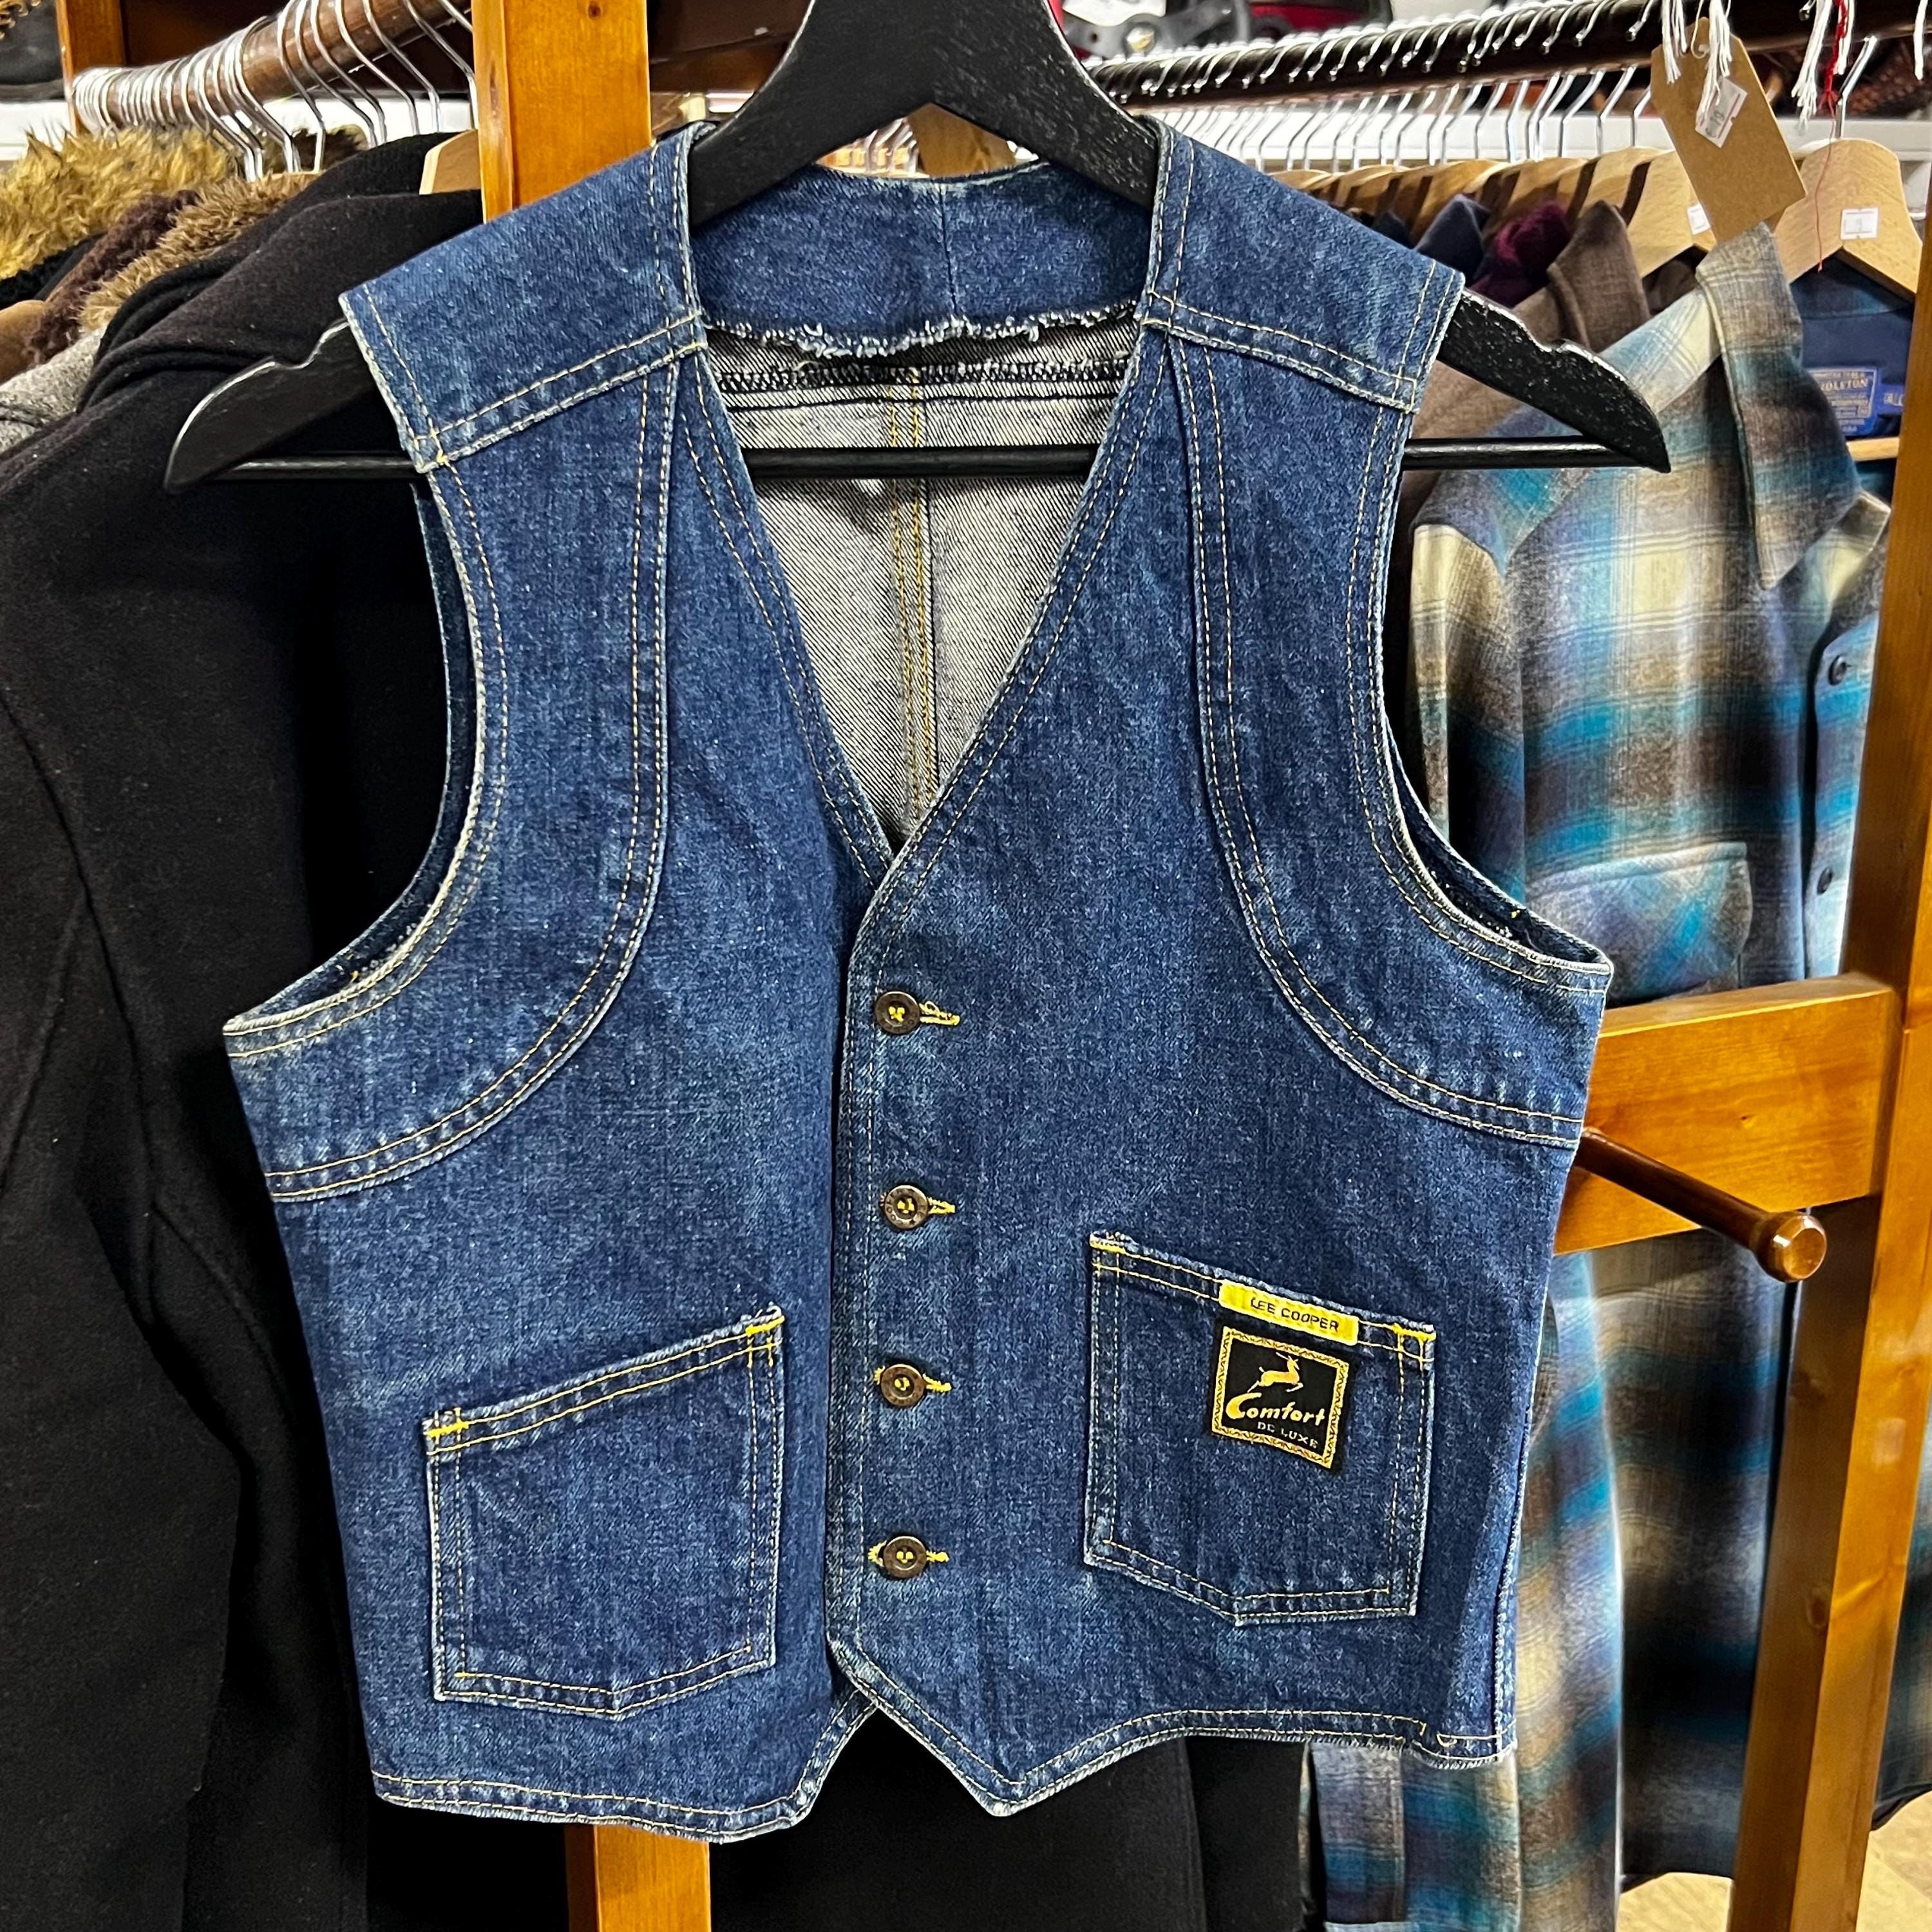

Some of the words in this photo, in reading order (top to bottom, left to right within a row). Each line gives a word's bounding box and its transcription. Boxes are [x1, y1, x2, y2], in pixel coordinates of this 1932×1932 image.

[1251, 1297, 1275, 1314] LEE
[1281, 1308, 1339, 1332] COOPER
[1226, 1392, 1325, 1426] Comfort
[1257, 1421, 1276, 1433] DE
[1281, 1427, 1319, 1449] LUXE
